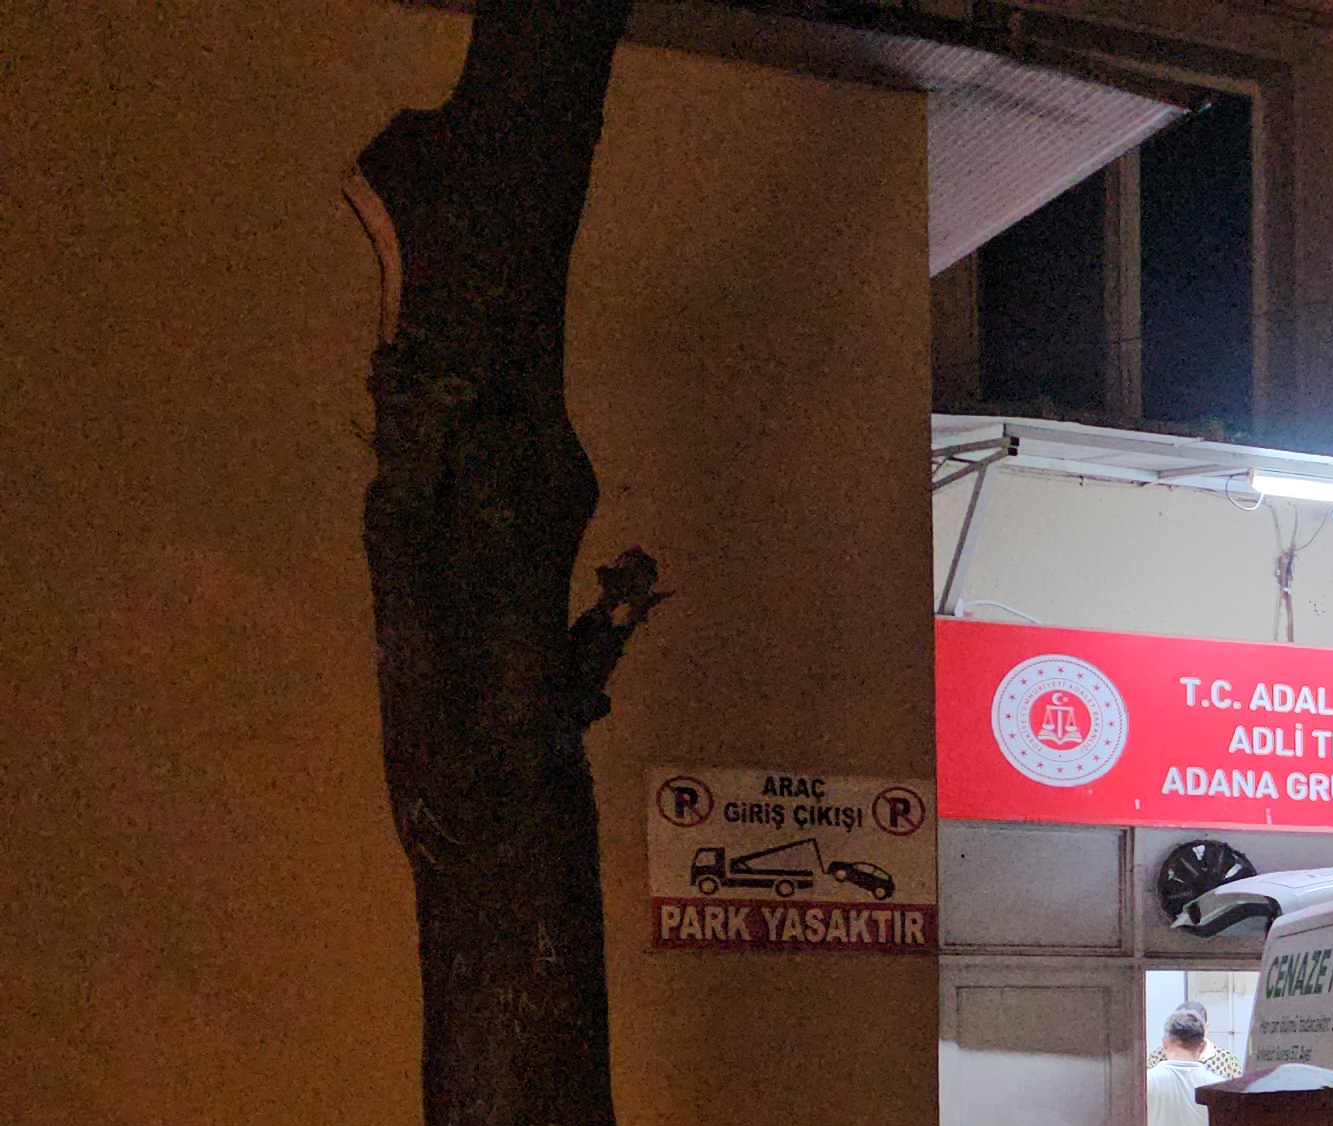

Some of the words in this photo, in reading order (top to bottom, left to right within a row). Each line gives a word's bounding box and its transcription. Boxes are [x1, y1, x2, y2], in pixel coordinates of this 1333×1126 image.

[1179, 676, 1242, 710] T.C.
[1228, 722, 1304, 758] ADLİ
[762, 776, 826, 803] ARAÇ
[1161, 766, 1280, 800] ADANA
[792, 804, 864, 833] ÇIKIŞI
[660, 904, 752, 942] PARK
[761, 906, 925, 945] YASAKTIR
[1266, 948, 1332, 999] CENAZE
